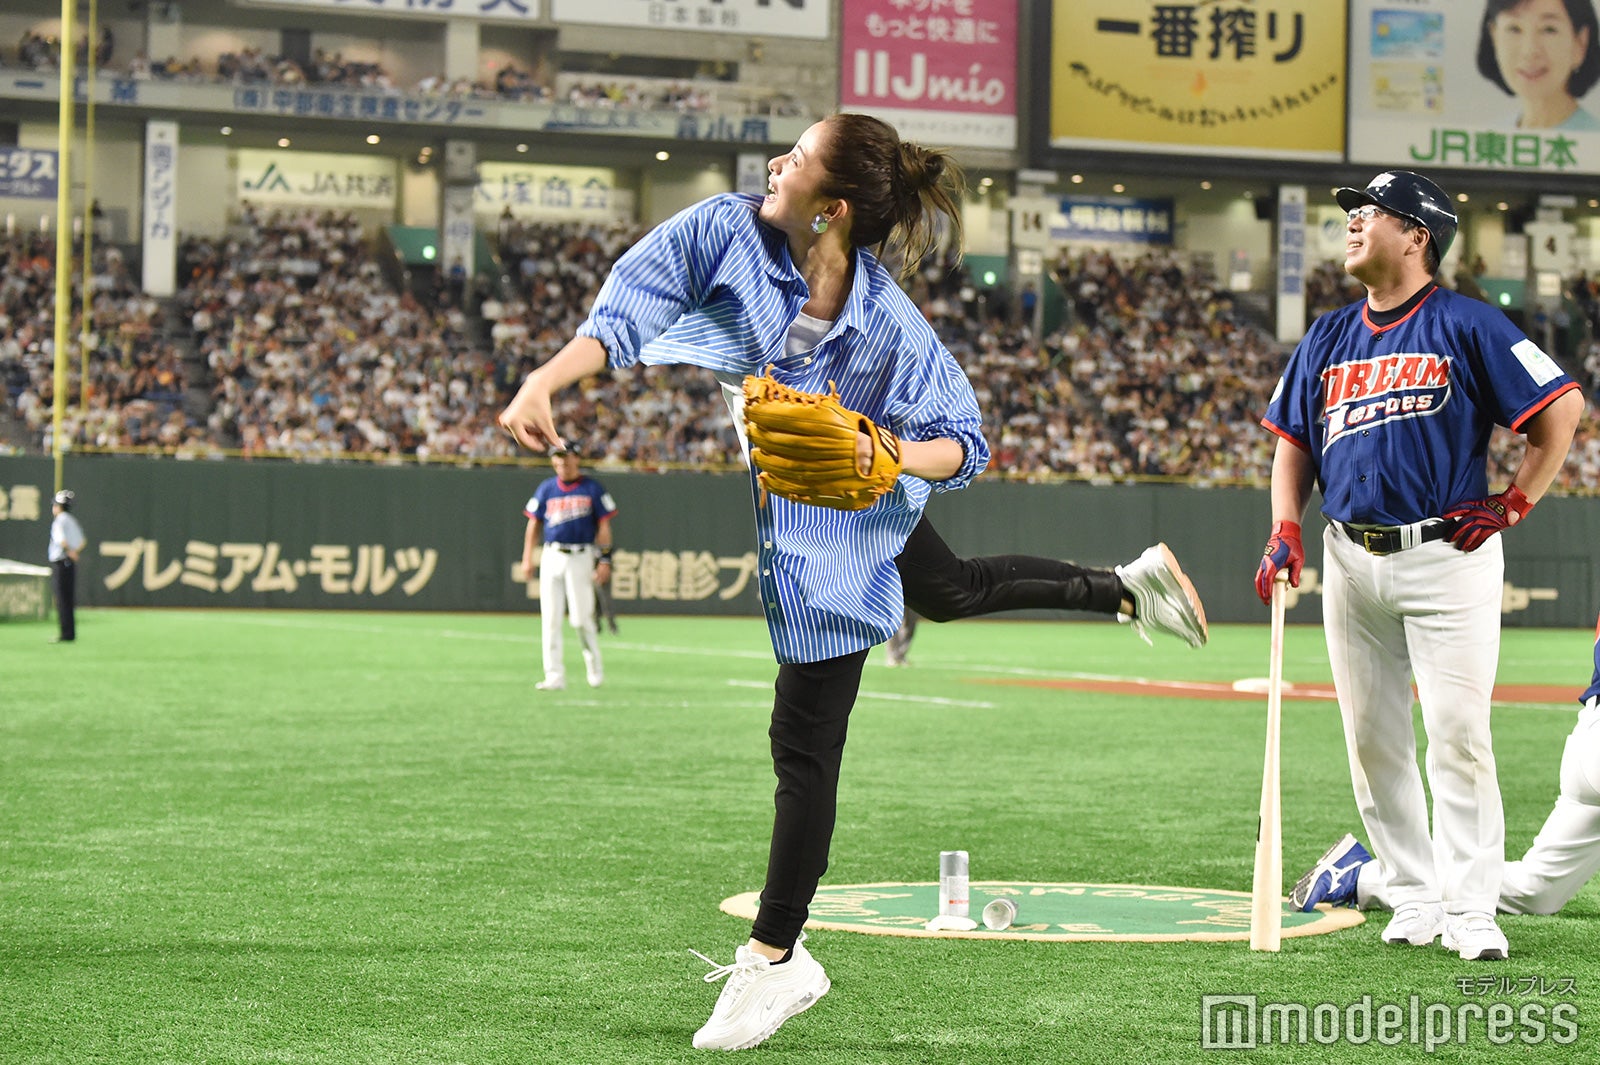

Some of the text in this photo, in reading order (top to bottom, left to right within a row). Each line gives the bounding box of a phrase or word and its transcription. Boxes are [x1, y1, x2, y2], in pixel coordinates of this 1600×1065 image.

[866, 13, 1000, 44] もっと快適に
[1410, 129, 1577, 167] JR東日本
[478, 173, 610, 209] 塚商会
[1321, 354, 1453, 410] DREAM
